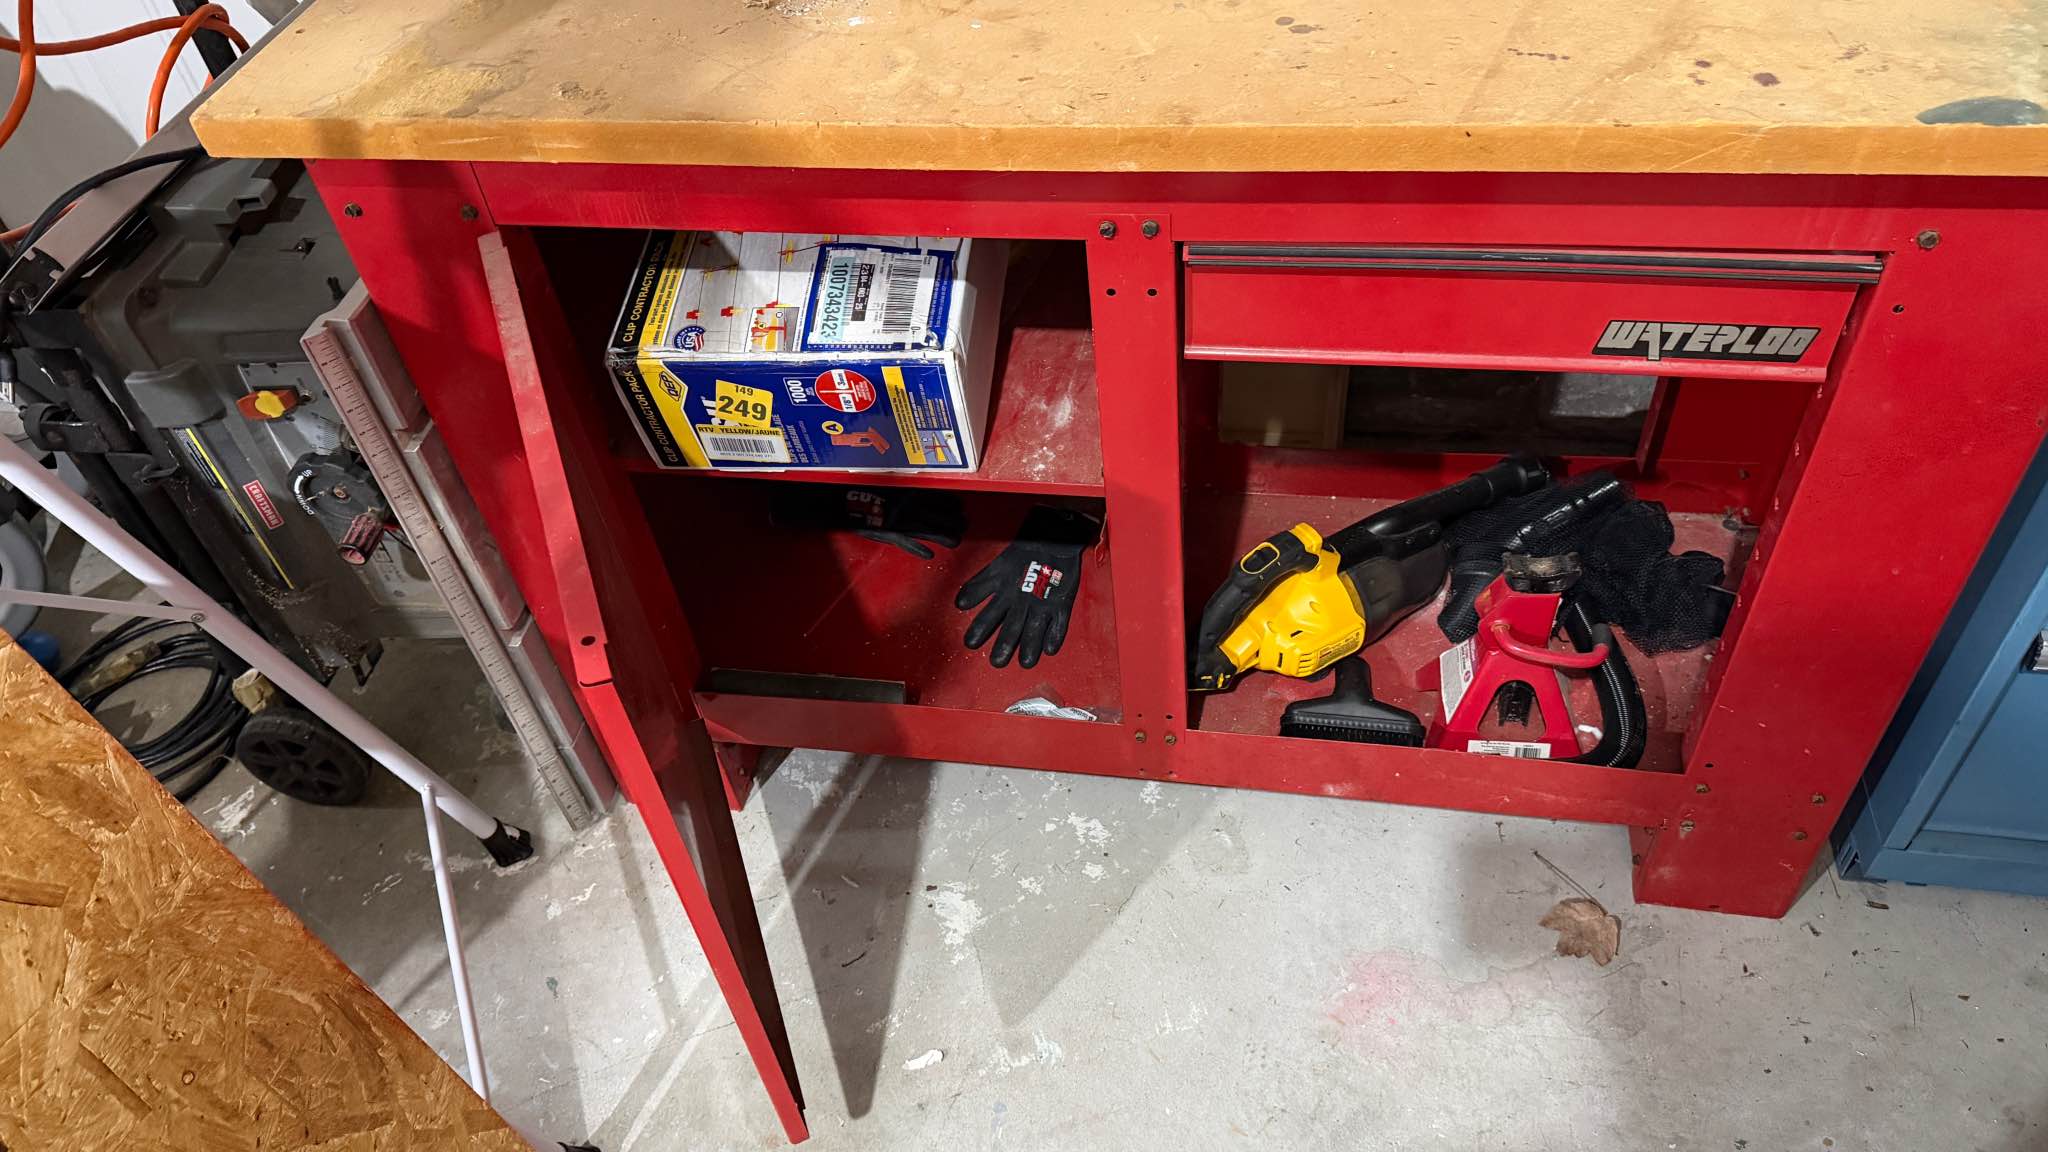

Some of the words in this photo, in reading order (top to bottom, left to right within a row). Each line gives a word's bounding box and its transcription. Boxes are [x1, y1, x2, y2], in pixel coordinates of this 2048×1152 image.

[622, 320, 635, 343] CLIP
[630, 262, 658, 321] CONTRACTOR
[684, 331, 698, 348] USA
[1597, 320, 1820, 361] WATERLOO
[623, 370, 642, 393] PACK
[734, 384, 754, 397] 149
[786, 379, 809, 405] 1000
[635, 394, 669, 445] CONTRACTOR
[717, 395, 768, 421] 249
[698, 426, 715, 435] RTV
[719, 426, 782, 437] YELLOW/JAUNE
[825, 423, 840, 432] A
[248, 485, 280, 526] CRAFTSMAN
[296, 494, 315, 515] DOWN
[846, 489, 887, 505] CUT
[1021, 560, 1042, 593] CUT
